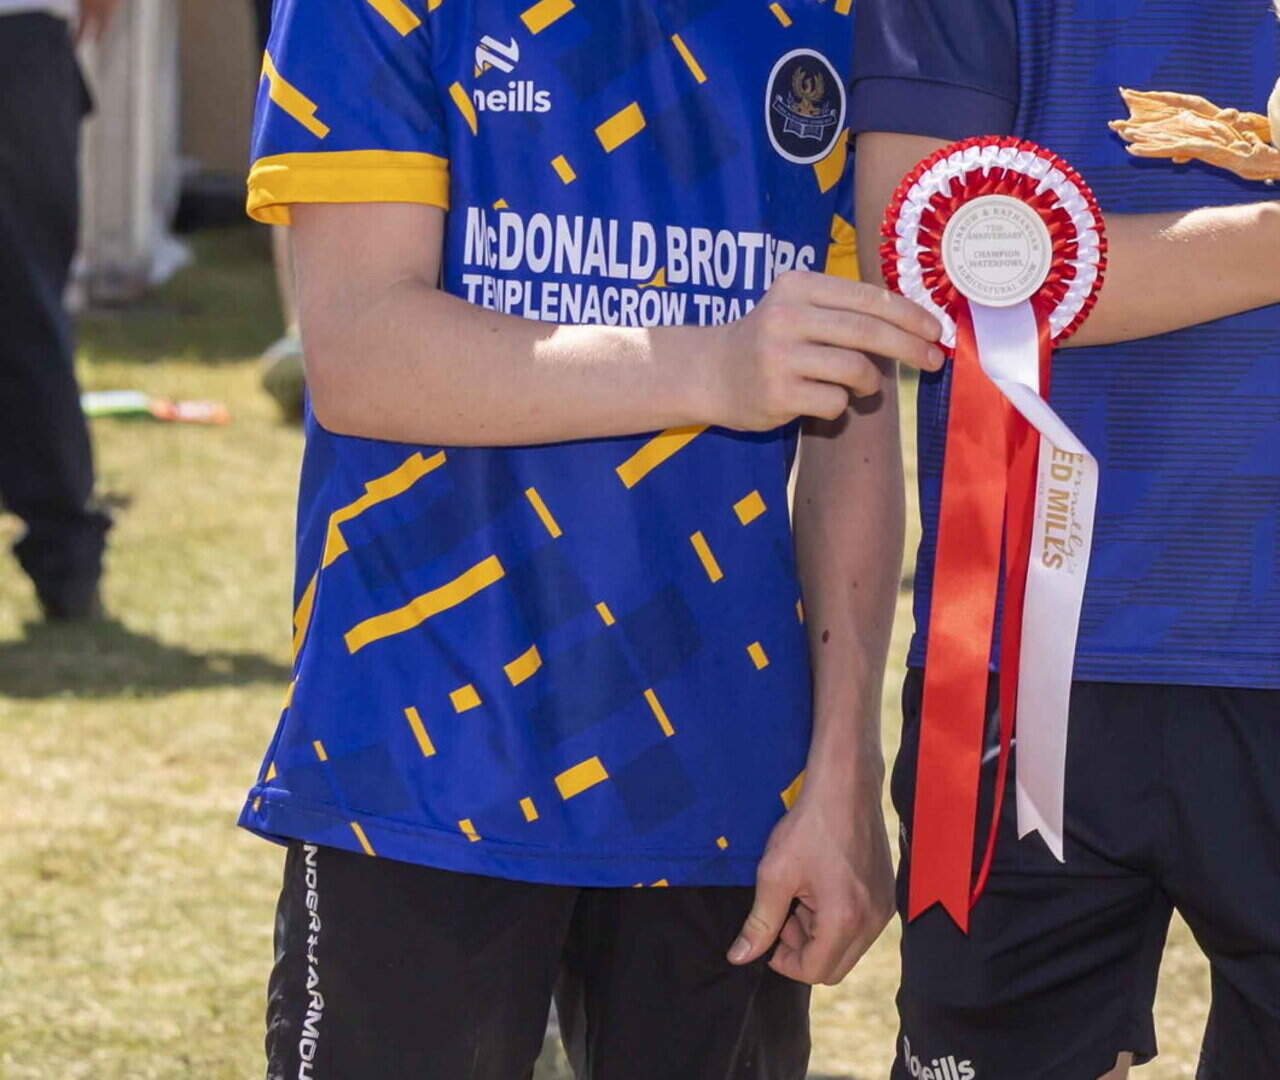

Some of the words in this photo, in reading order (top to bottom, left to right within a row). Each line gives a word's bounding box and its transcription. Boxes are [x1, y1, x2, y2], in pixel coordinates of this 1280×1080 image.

[463, 207, 656, 280] McDONALD
[667, 226, 815, 291] BROTRS
[1042, 487, 1071, 569] MILLS
[303, 841, 321, 932] NDER
